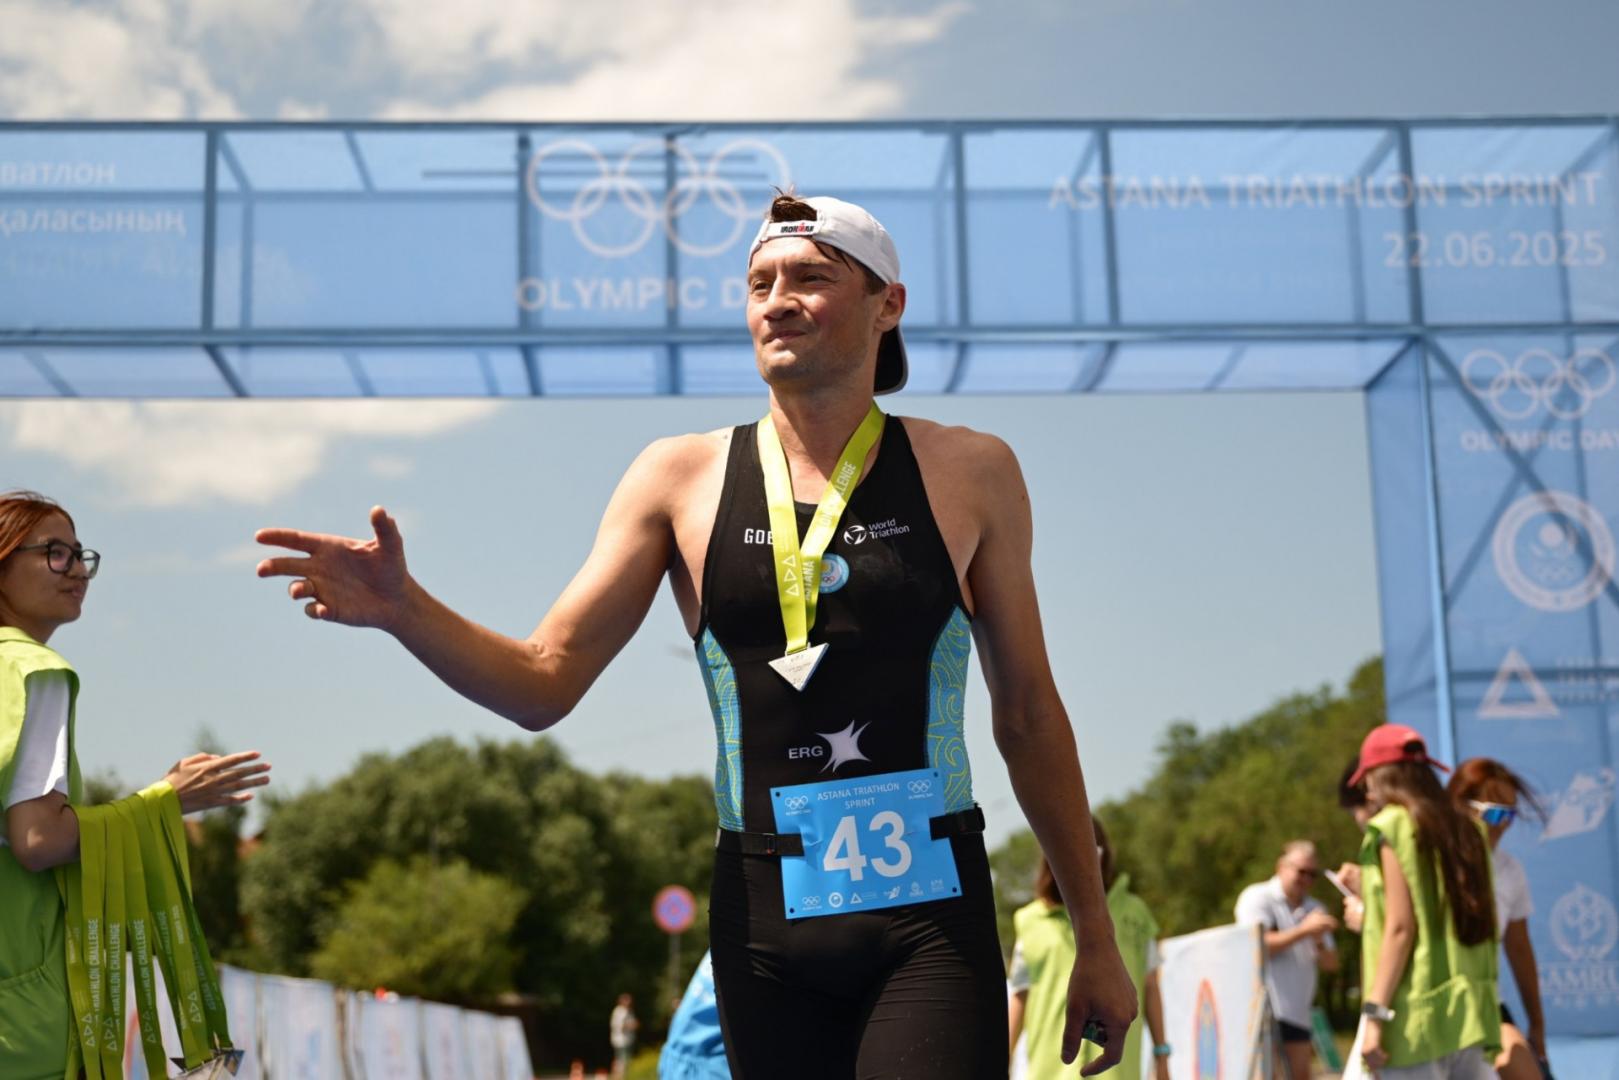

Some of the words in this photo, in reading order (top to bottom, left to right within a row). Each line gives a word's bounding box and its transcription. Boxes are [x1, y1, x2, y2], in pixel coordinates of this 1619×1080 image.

[1049, 174, 1212, 211] ASTANA
[1221, 172, 1447, 210] TRIATHLON
[1460, 170, 1602, 208] SPRINT
[1382, 230, 1607, 268] 22.06.2025
[515, 276, 708, 311] OLYMPIC
[868, 518, 896, 531] World
[869, 525, 910, 539] Triathlon
[788, 745, 824, 759] ERG
[817, 789, 851, 801] ASTANA
[854, 783, 900, 796] TRIATHLON
[844, 797, 875, 810] SPRINT
[823, 810, 913, 882] 43
